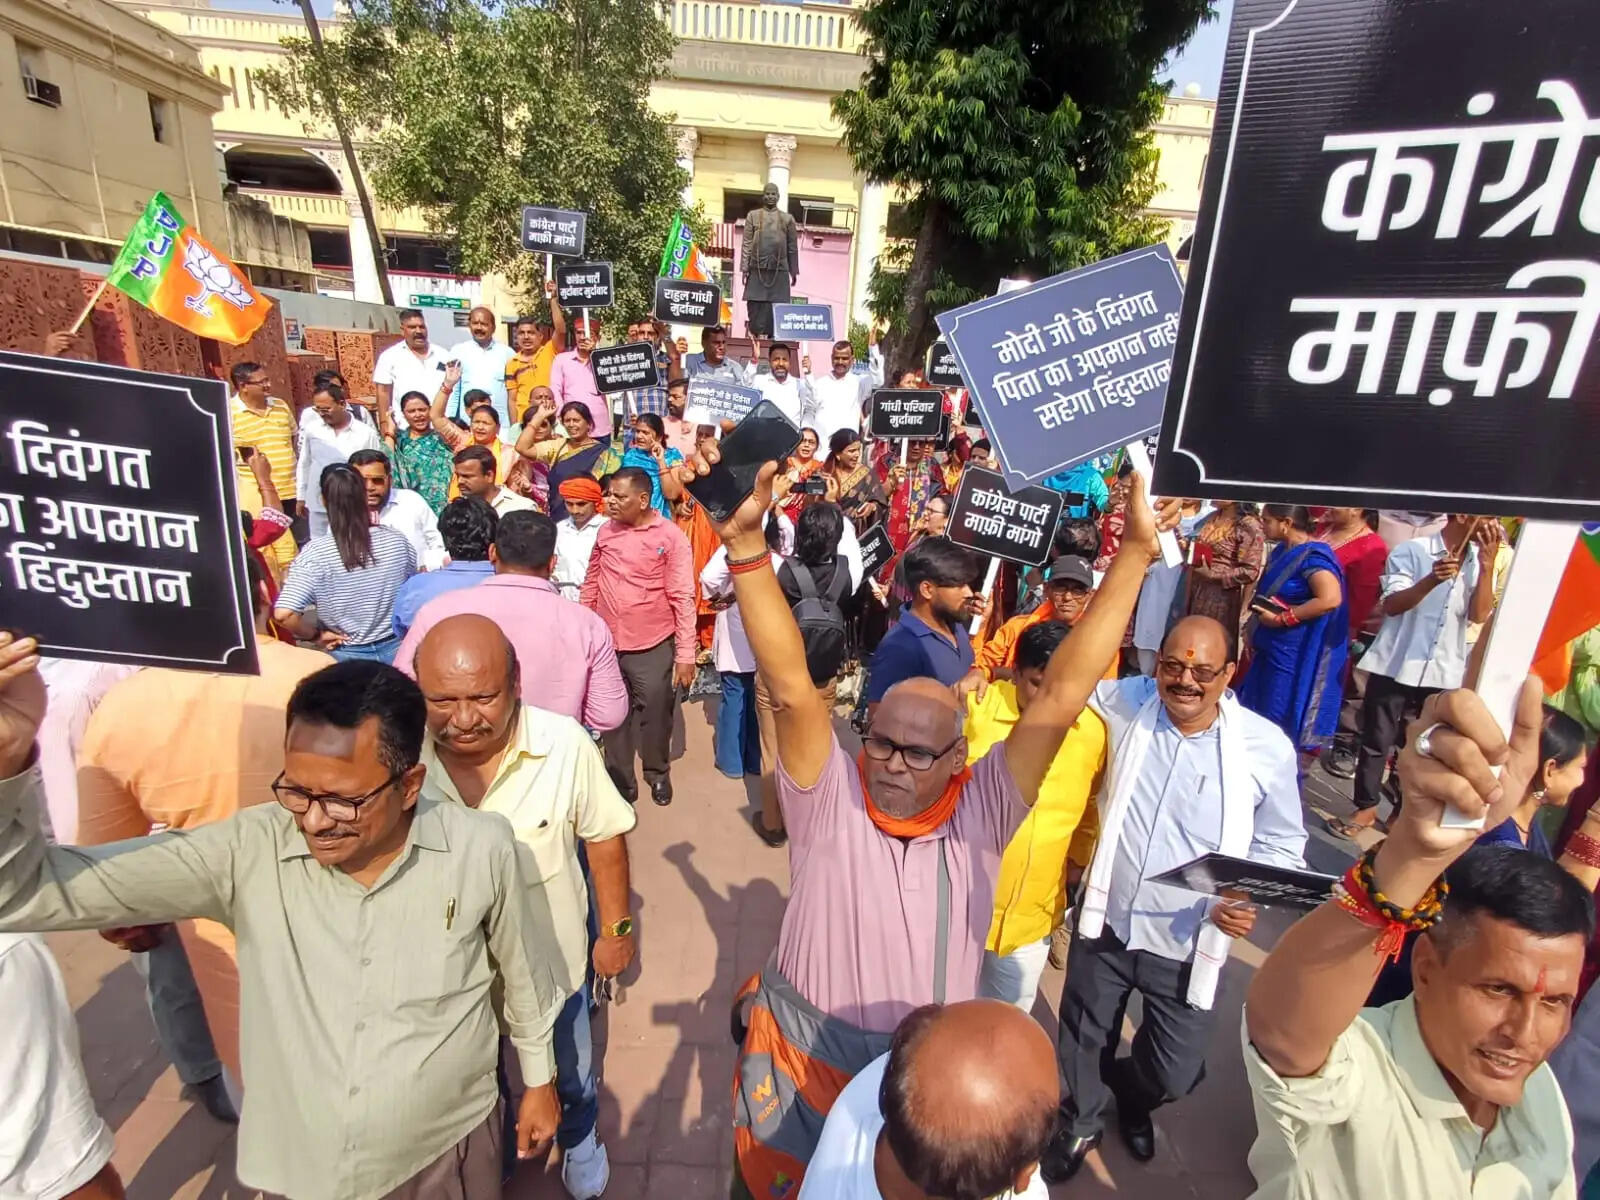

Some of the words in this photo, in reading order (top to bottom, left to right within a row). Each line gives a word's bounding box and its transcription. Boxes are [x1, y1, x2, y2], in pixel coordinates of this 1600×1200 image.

[1320, 79, 1600, 241] कांग्रे
[529, 217, 557, 231] कांग्रेस
[558, 220, 578, 234] पार्टी
[553, 234, 576, 247] मांगो
[663, 288, 690, 303] राहुल
[691, 290, 714, 304] गांधी
[670, 302, 705, 317] मुर्दाबाद
[991, 323, 1047, 365] मोदी
[1043, 313, 1076, 347] जी
[1072, 308, 1098, 337] के
[1095, 289, 1159, 330] दिवंगत
[992, 369, 1043, 406] पिता
[1038, 357, 1073, 387] का
[1072, 331, 1147, 377] अपमान
[880, 399, 902, 412] गांधी
[903, 399, 935, 413] परिवार
[889, 413, 925, 428] मुर्दाबाद
[1033, 391, 1096, 430] सहेगा
[6, 420, 151, 490] दिवंगत
[36, 496, 200, 553] अपमान
[971, 488, 1019, 517] कांग्रेस
[1019, 502, 1052, 526] पार्टी
[964, 511, 1007, 538] माफ़ी
[1006, 523, 1044, 549] मांगो
[5, 541, 192, 609] हिंदुस्तान
